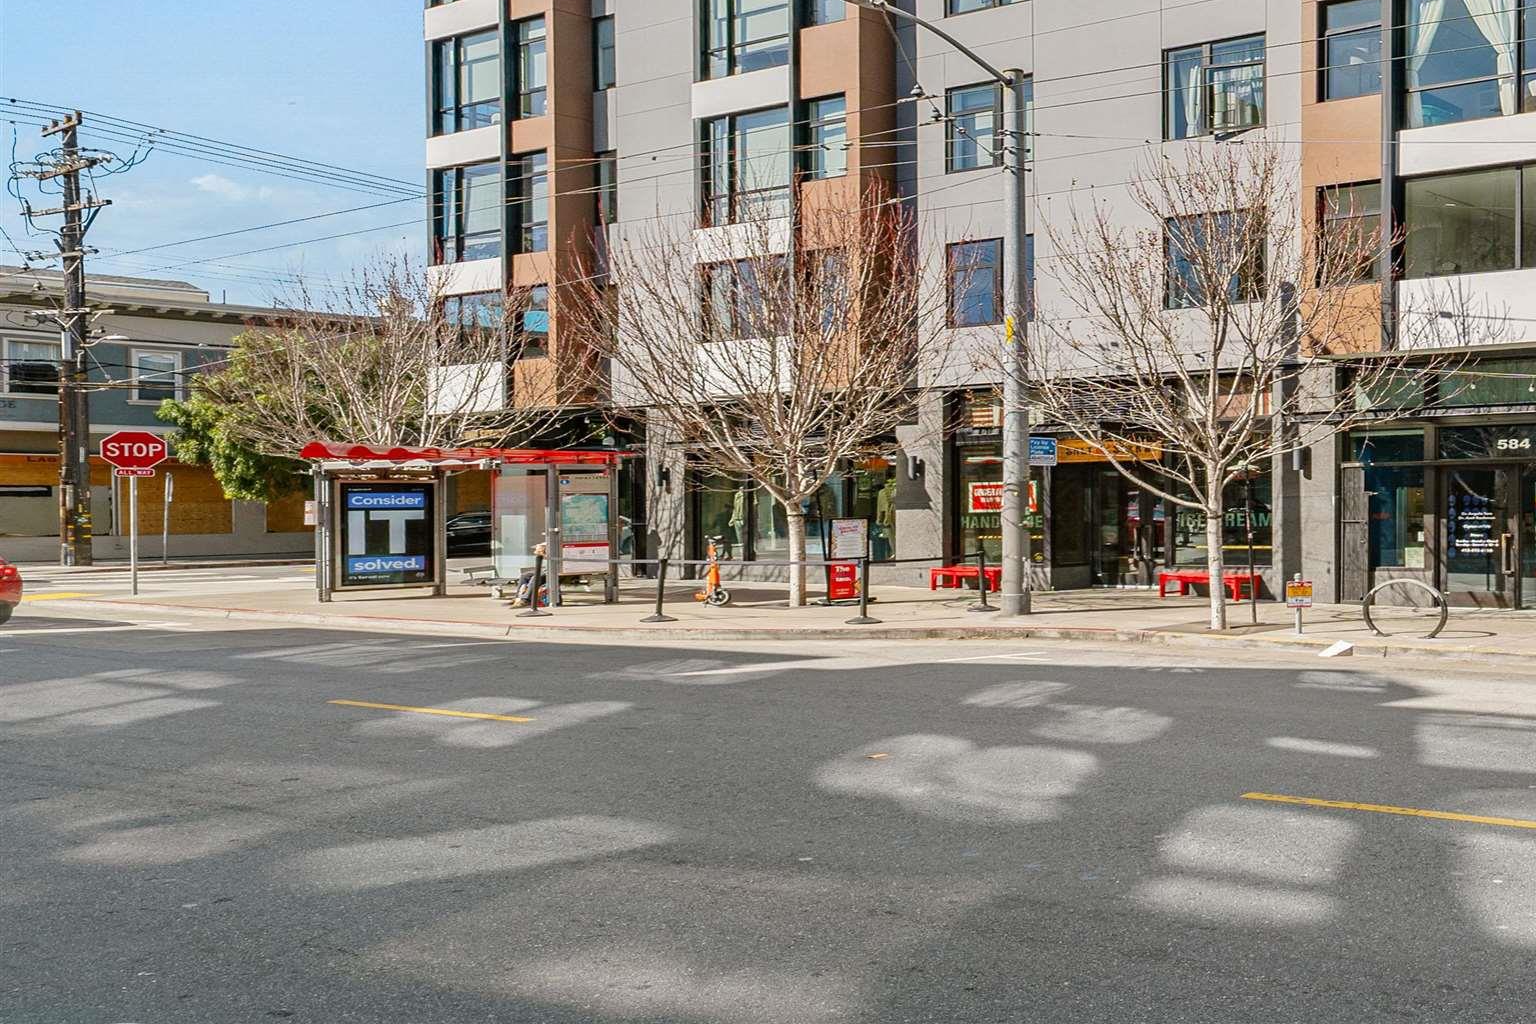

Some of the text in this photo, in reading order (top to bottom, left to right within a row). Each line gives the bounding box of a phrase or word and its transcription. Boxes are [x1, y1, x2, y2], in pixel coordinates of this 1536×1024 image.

[106, 442, 162, 457] STOP
[1497, 438, 1531, 450] 584
[351, 495, 422, 505] Consider
[1224, 513, 1272, 527] REAM
[348, 509, 425, 555] IT
[354, 558, 420, 571] solved.
